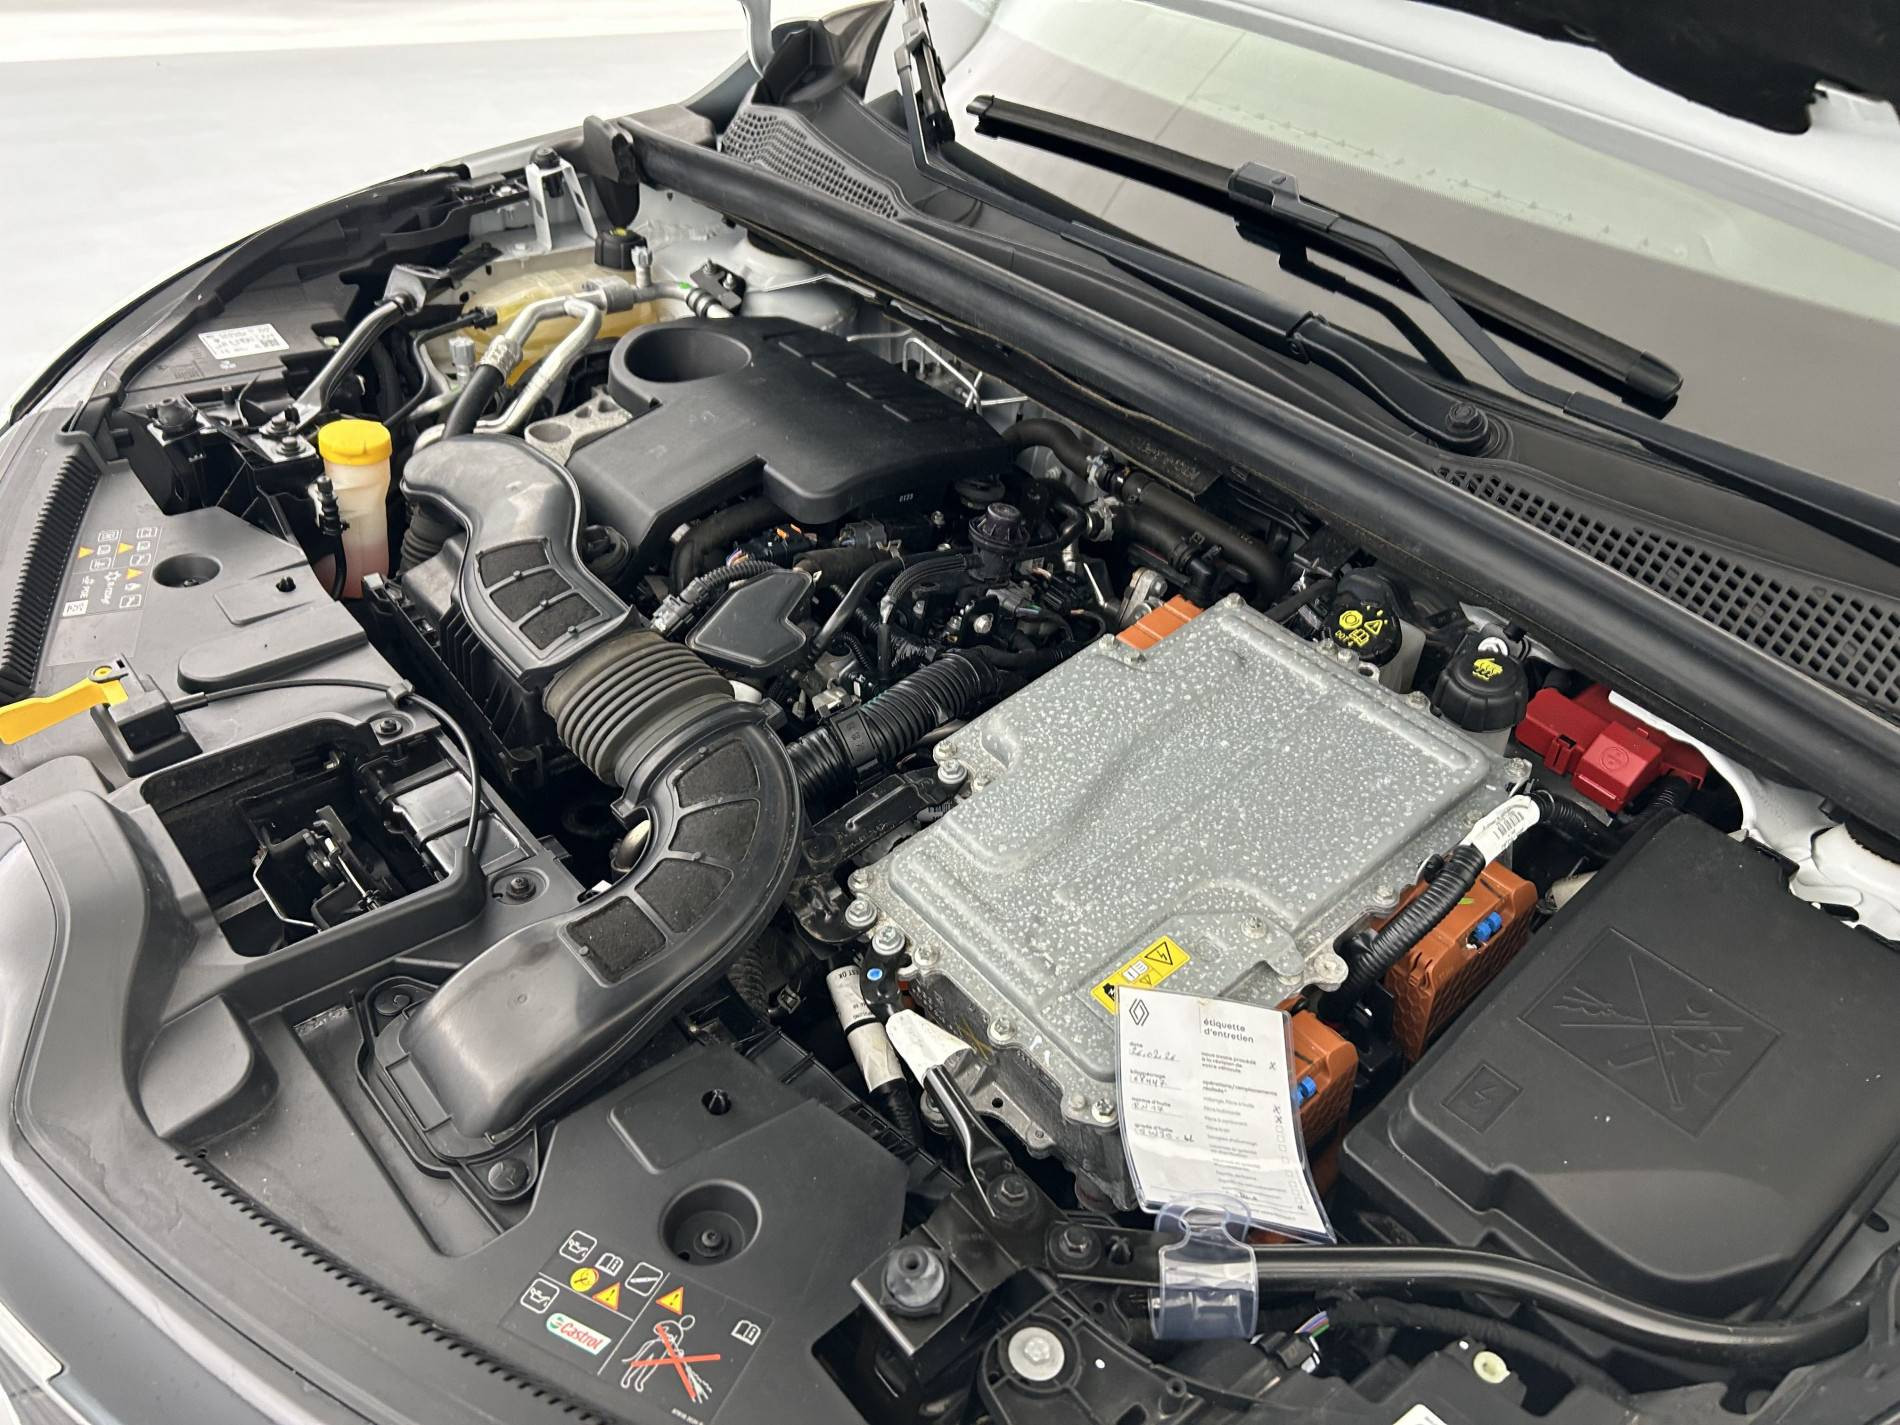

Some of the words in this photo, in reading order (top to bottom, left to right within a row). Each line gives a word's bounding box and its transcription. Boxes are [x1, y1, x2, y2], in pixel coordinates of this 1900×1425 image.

[1335, 630, 1349, 642] DOT
[1203, 1018, 1246, 1032] étiquette
[1204, 1027, 1254, 1043] d'entretien
[560, 1322, 603, 1350] Castrol
